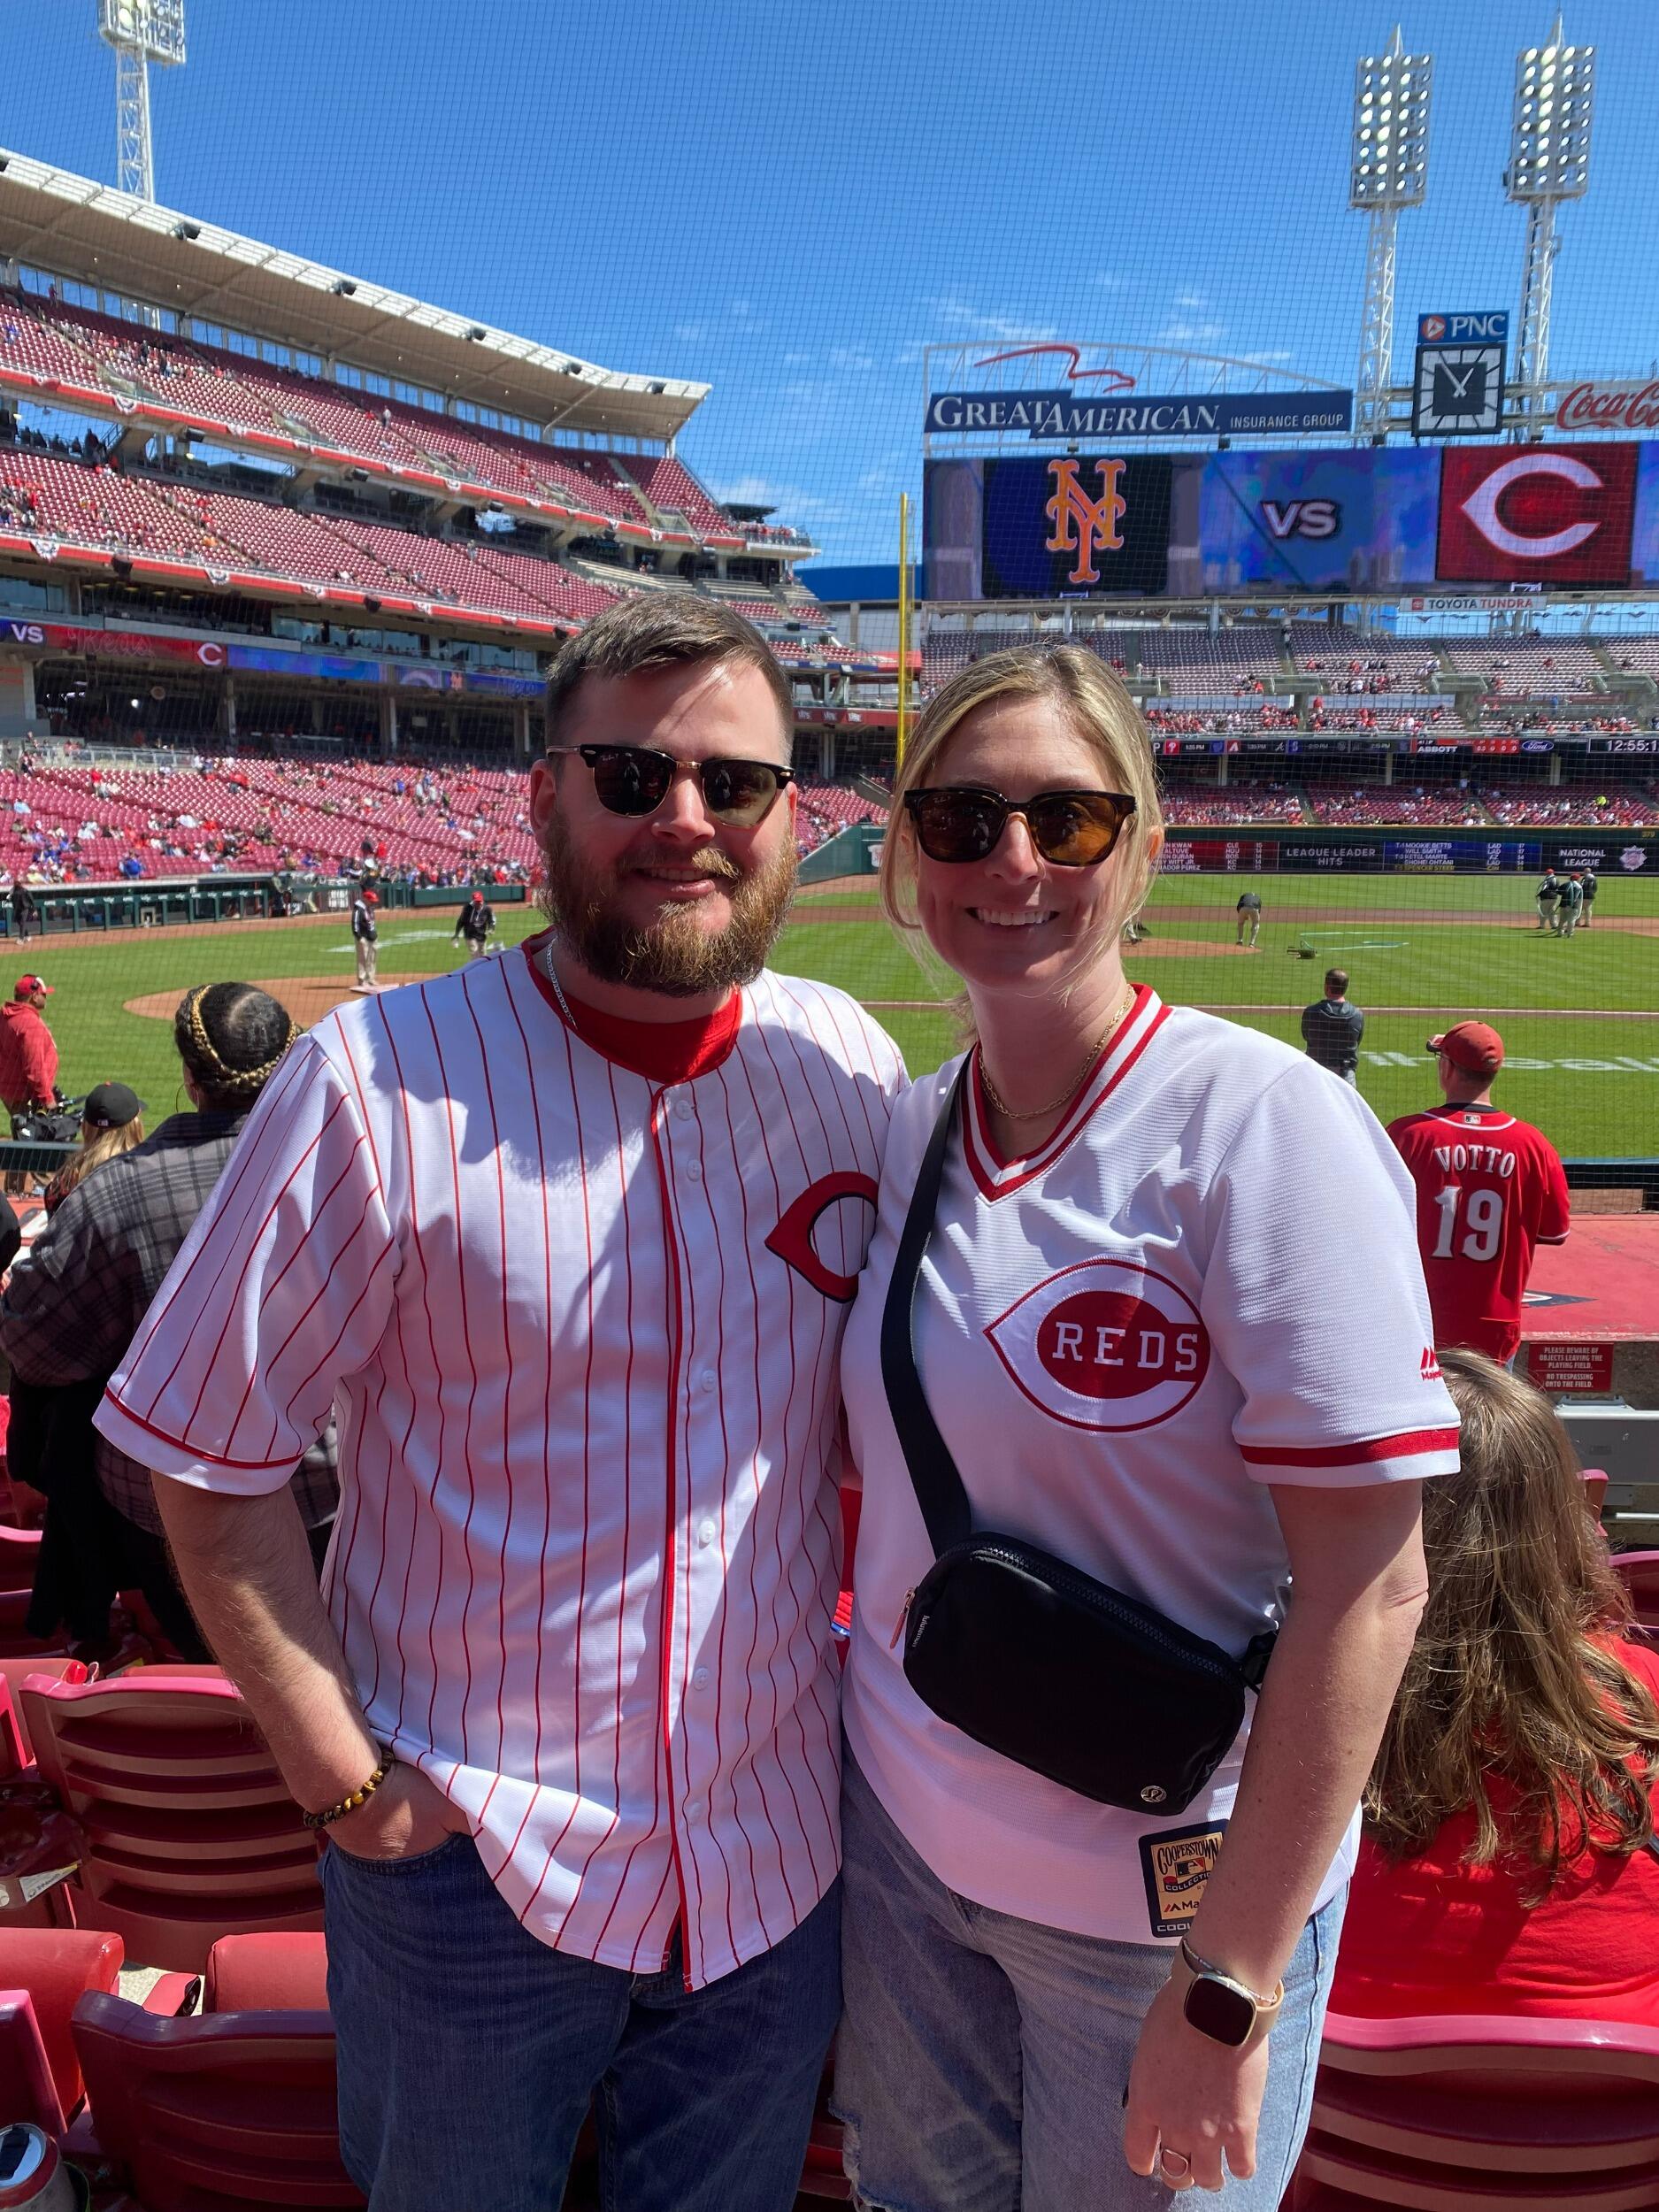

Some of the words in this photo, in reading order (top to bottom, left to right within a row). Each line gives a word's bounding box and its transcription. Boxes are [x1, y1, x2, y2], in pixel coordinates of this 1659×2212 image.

[1450, 314, 1505, 338] PNC
[933, 396, 1050, 426] GREAT
[1037, 403, 1220, 433] AMERICAN
[1230, 414, 1299, 429] INSURANCE
[1303, 413, 1344, 427] GROUP
[1460, 452, 1606, 558] C
[1260, 499, 1338, 538] VS
[1428, 598, 1478, 610] TOYOTA
[1480, 598, 1534, 609] TUNDRA
[11, 623, 44, 644] VS
[1528, 741, 1547, 750] Ford
[1286, 848, 1330, 856] LEAGUE
[1333, 848, 1376, 856] LEADER
[1317, 857, 1343, 866] HITS
[1559, 849, 1607, 857] NATIONAL
[1564, 858, 1601, 867] LEAGUE
[1434, 1144, 1516, 1178] VOTTO
[1432, 1185, 1503, 1262] 19
[1051, 1321, 1198, 1372] REDS
